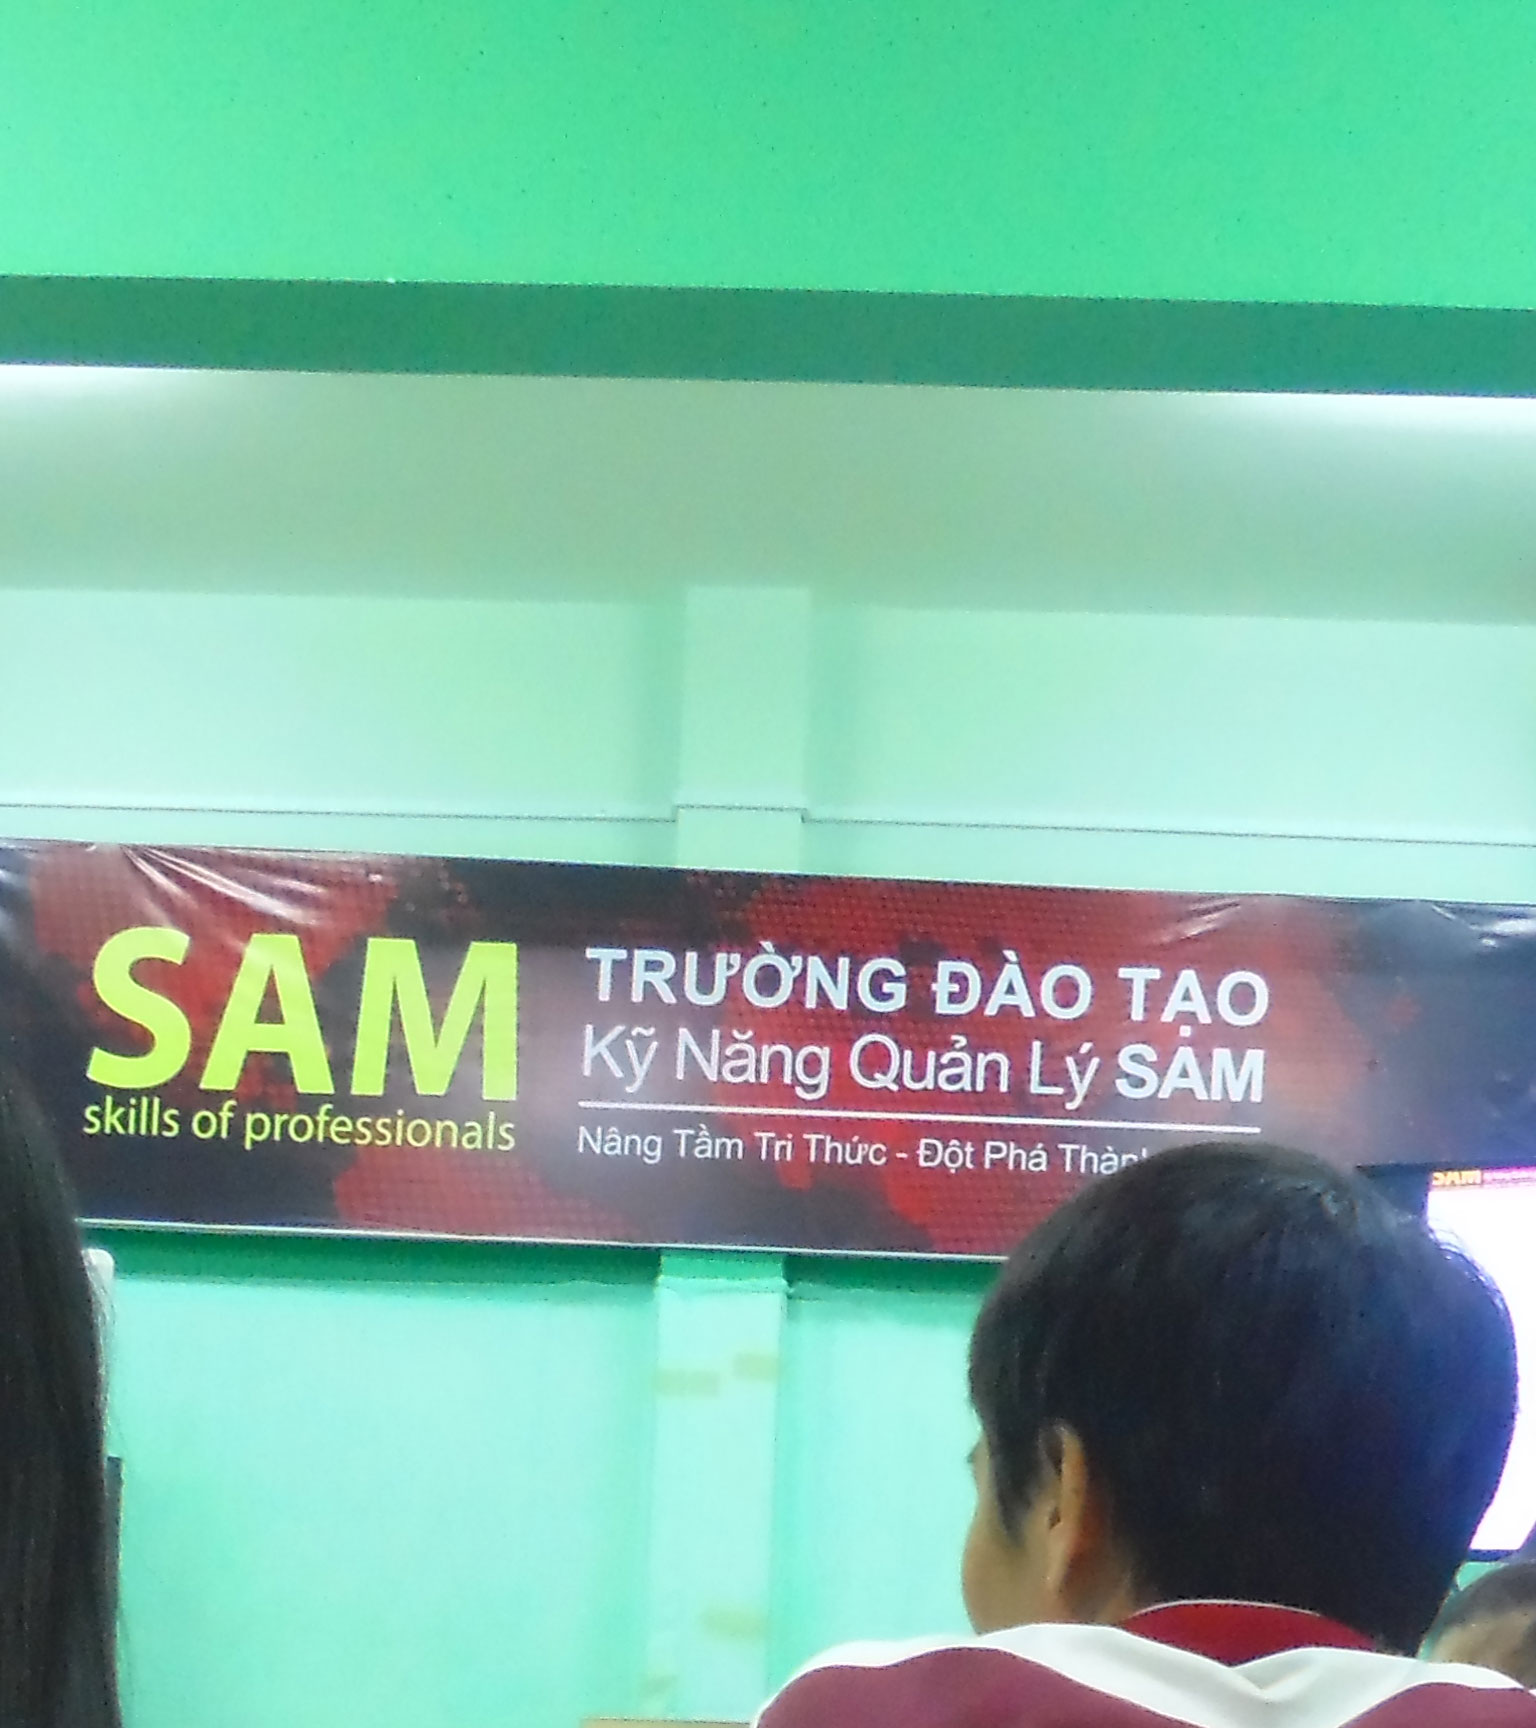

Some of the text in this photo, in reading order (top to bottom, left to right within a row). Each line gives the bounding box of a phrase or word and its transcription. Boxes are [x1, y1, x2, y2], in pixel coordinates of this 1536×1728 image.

[86, 926, 519, 1101] SAM
[585, 940, 1270, 1038] TRƯỜNG ĐÀO TẠO
[582, 1024, 1265, 1111] Kỹ Năng Quản Lý SAM
[83, 1094, 517, 1152] skills of professionals
[578, 1126, 663, 1165] Nâng
[674, 1124, 744, 1160] Tầm
[803, 1134, 888, 1166] Thức
[918, 1138, 975, 1174] Đột
[983, 1141, 1049, 1172] Phá
[1056, 1143, 1149, 1176] Thàn
